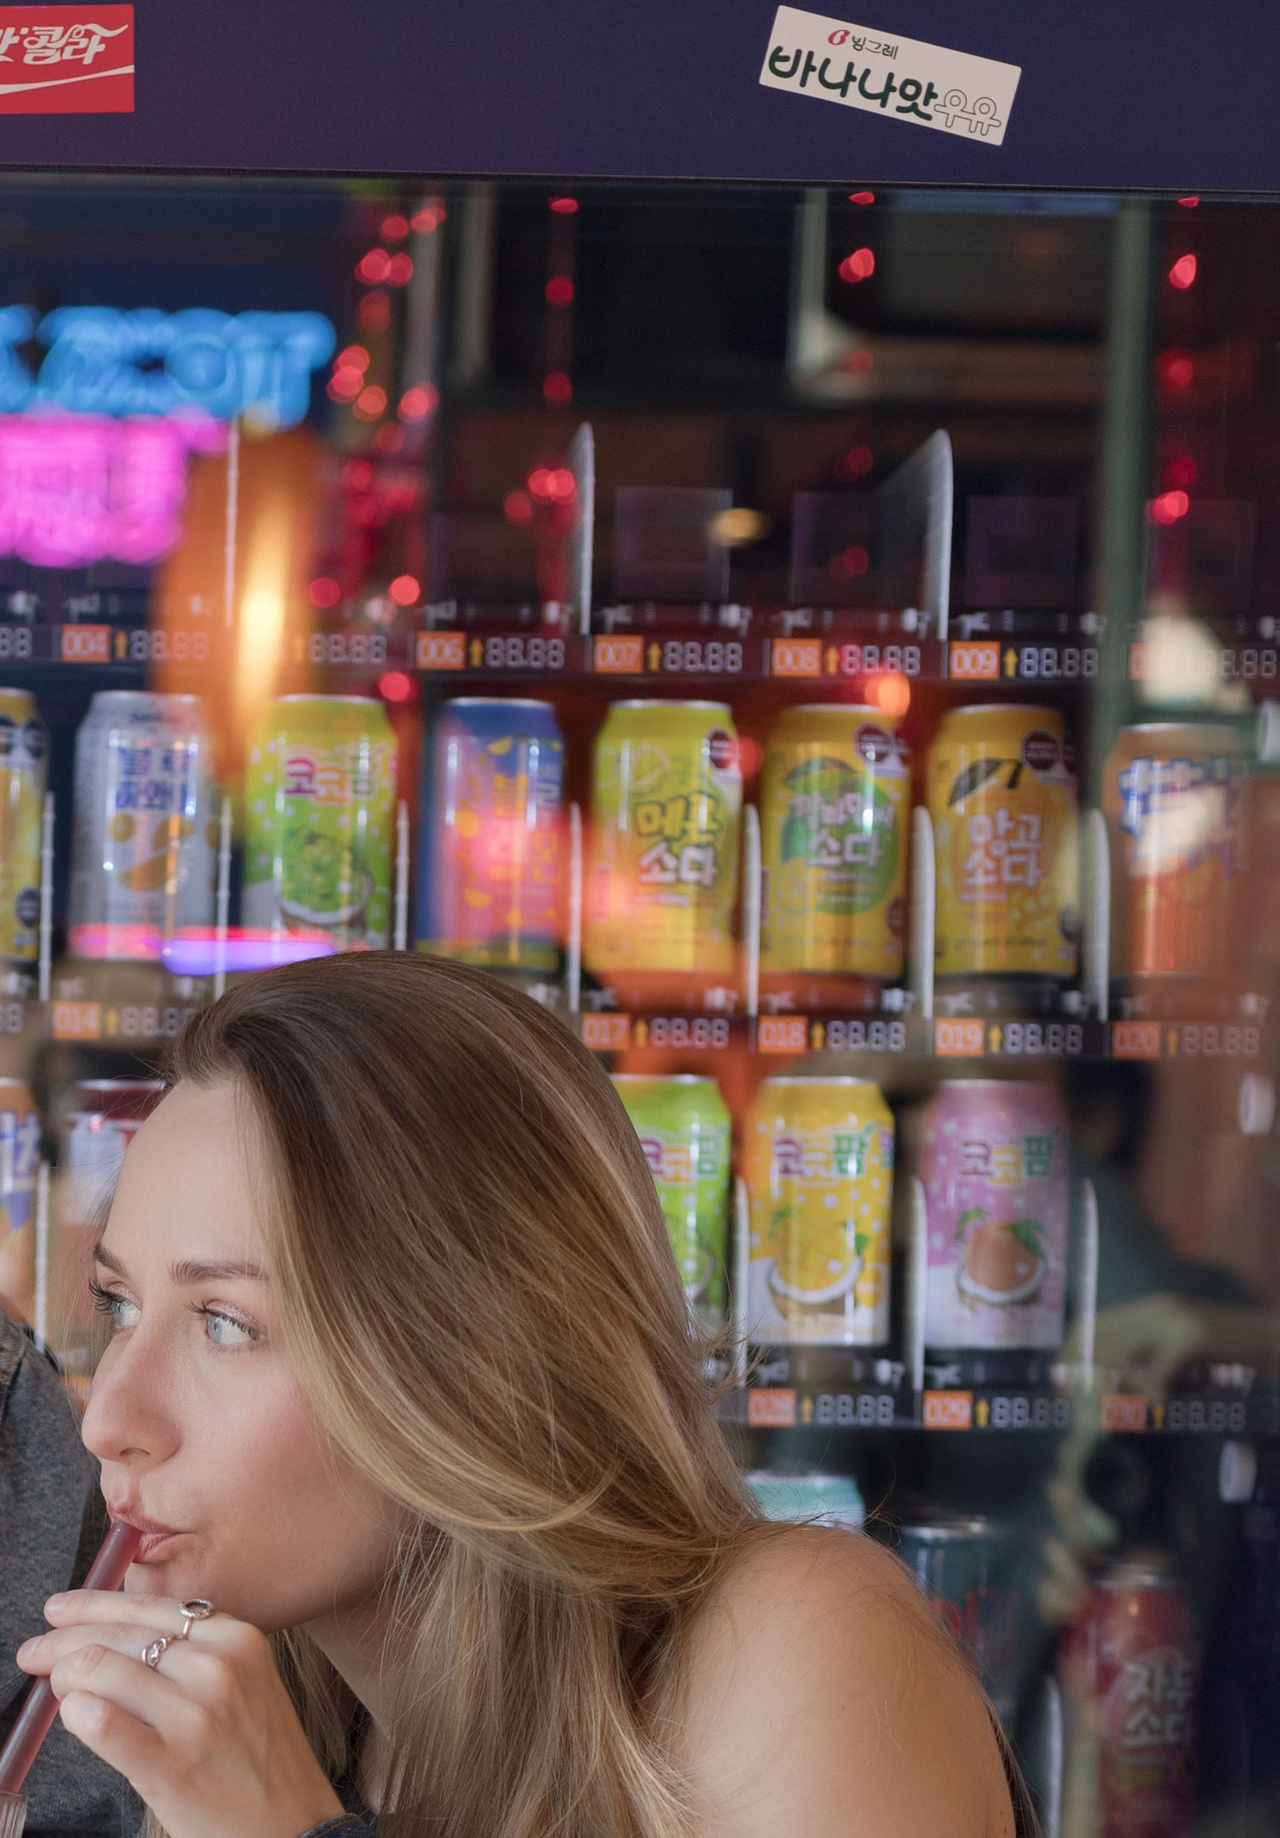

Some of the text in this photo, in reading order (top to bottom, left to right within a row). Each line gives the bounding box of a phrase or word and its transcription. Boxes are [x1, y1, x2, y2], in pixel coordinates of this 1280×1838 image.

[852, 35, 899, 60] 빙그레
[63, 630, 109, 658] 004
[418, 636, 464, 665] 006
[596, 640, 641, 668] 007
[774, 643, 819, 673] 008
[951, 647, 998, 676] 009
[970, 808, 1043, 856] 망고
[805, 829, 884, 869] 소다
[639, 842, 718, 888] 소다
[963, 851, 1044, 888] 소다
[54, 1005, 100, 1034] 014
[583, 1019, 627, 1048] 017
[936, 1023, 982, 1051] 019
[774, 1132, 868, 1184] 코코팜
[961, 1132, 1054, 1186] 코코팜
[925, 1393, 970, 1425] 029
